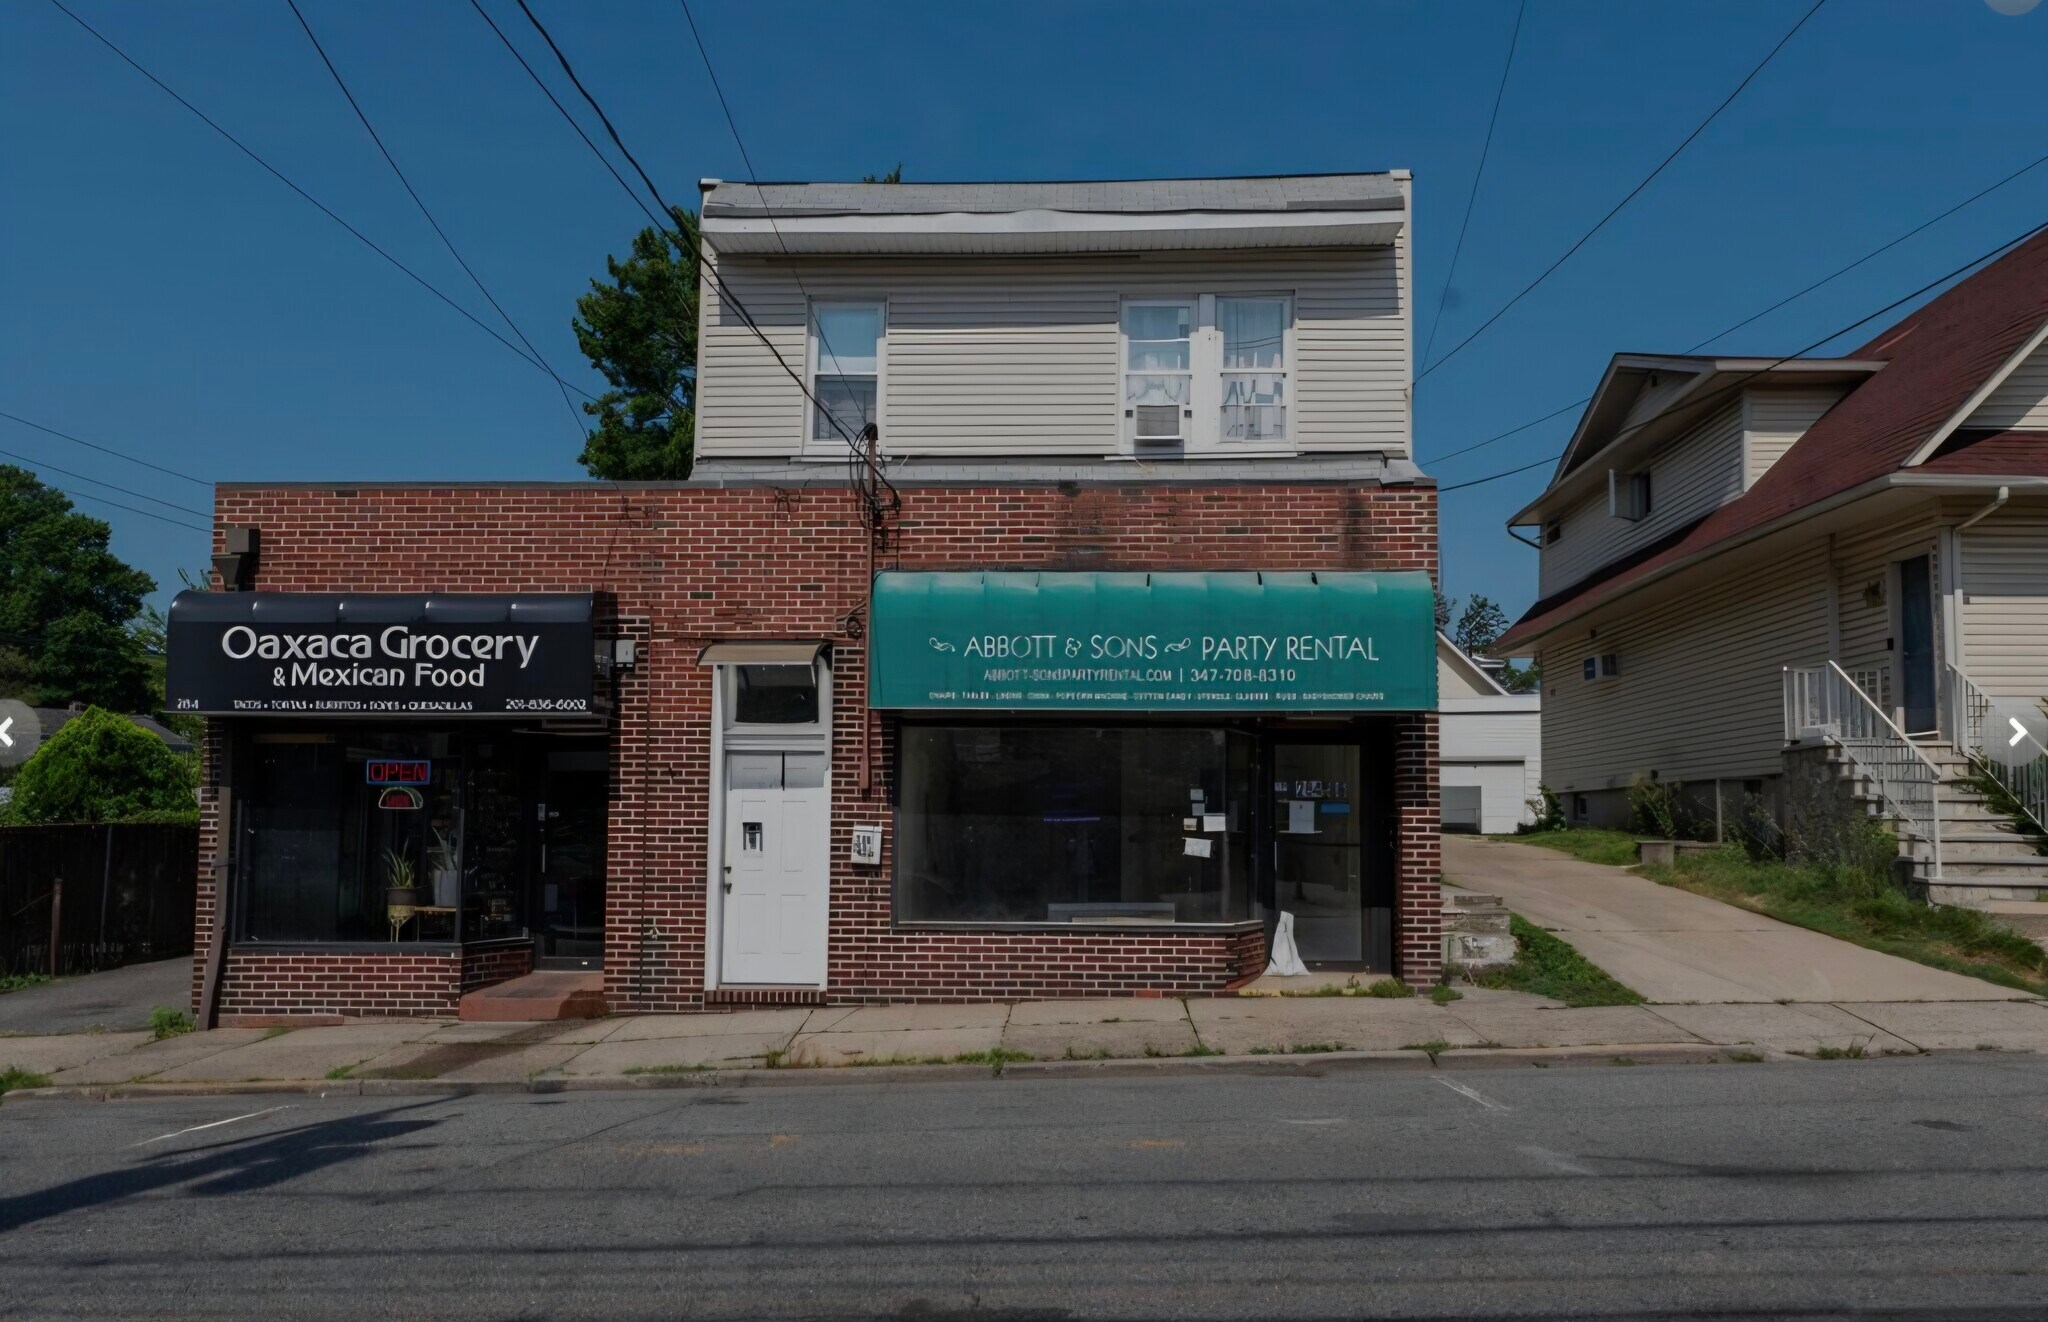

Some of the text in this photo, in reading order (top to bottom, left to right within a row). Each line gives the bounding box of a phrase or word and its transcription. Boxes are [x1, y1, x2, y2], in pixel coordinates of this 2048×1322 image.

[221, 625, 540, 669] Oaxaca Grocery
[963, 634, 1380, 662] ABBOTT & SONS PARTY RENTAL
[273, 662, 485, 688] & Mexican Food
[370, 763, 427, 782] OPEN
